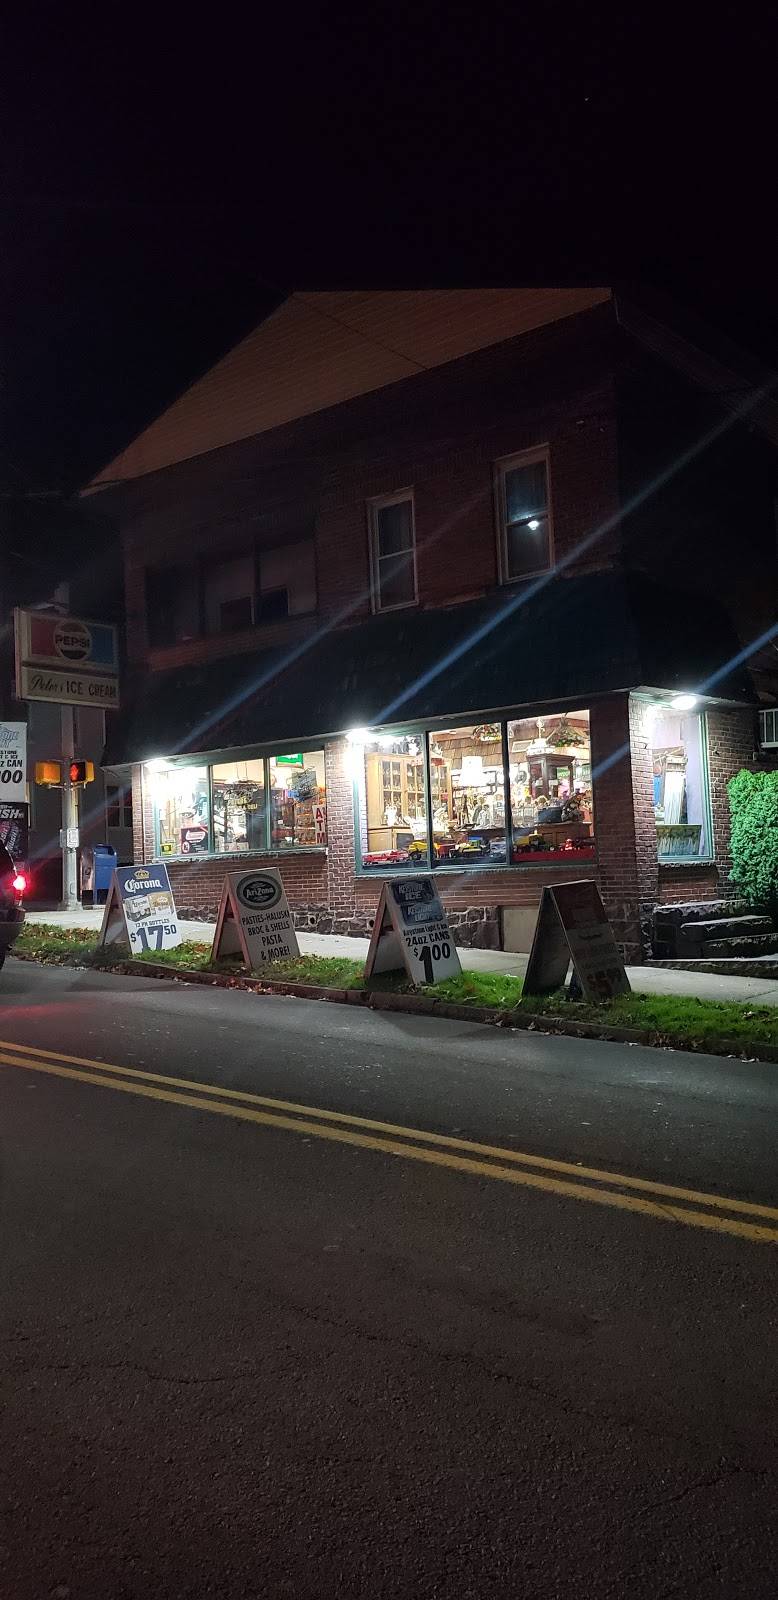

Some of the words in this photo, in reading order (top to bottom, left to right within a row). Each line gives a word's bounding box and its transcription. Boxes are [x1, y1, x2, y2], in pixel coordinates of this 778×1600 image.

[56, 634, 90, 648] PEPSI
[66, 680, 84, 695] ICE
[88, 683, 117, 698] CREAM
[7, 759, 23, 768] CAN
[0, 769, 23, 784] 00
[124, 879, 163, 894] Corona
[246, 887, 274, 898] AriZona
[248, 926, 264, 936] BROC
[265, 925, 270, 933] &
[270, 921, 290, 932] SHELLS
[261, 934, 283, 946] PASTA
[430, 931, 450, 943] CANS
[261, 951, 267, 960] &
[268, 946, 291, 961] MORE!
